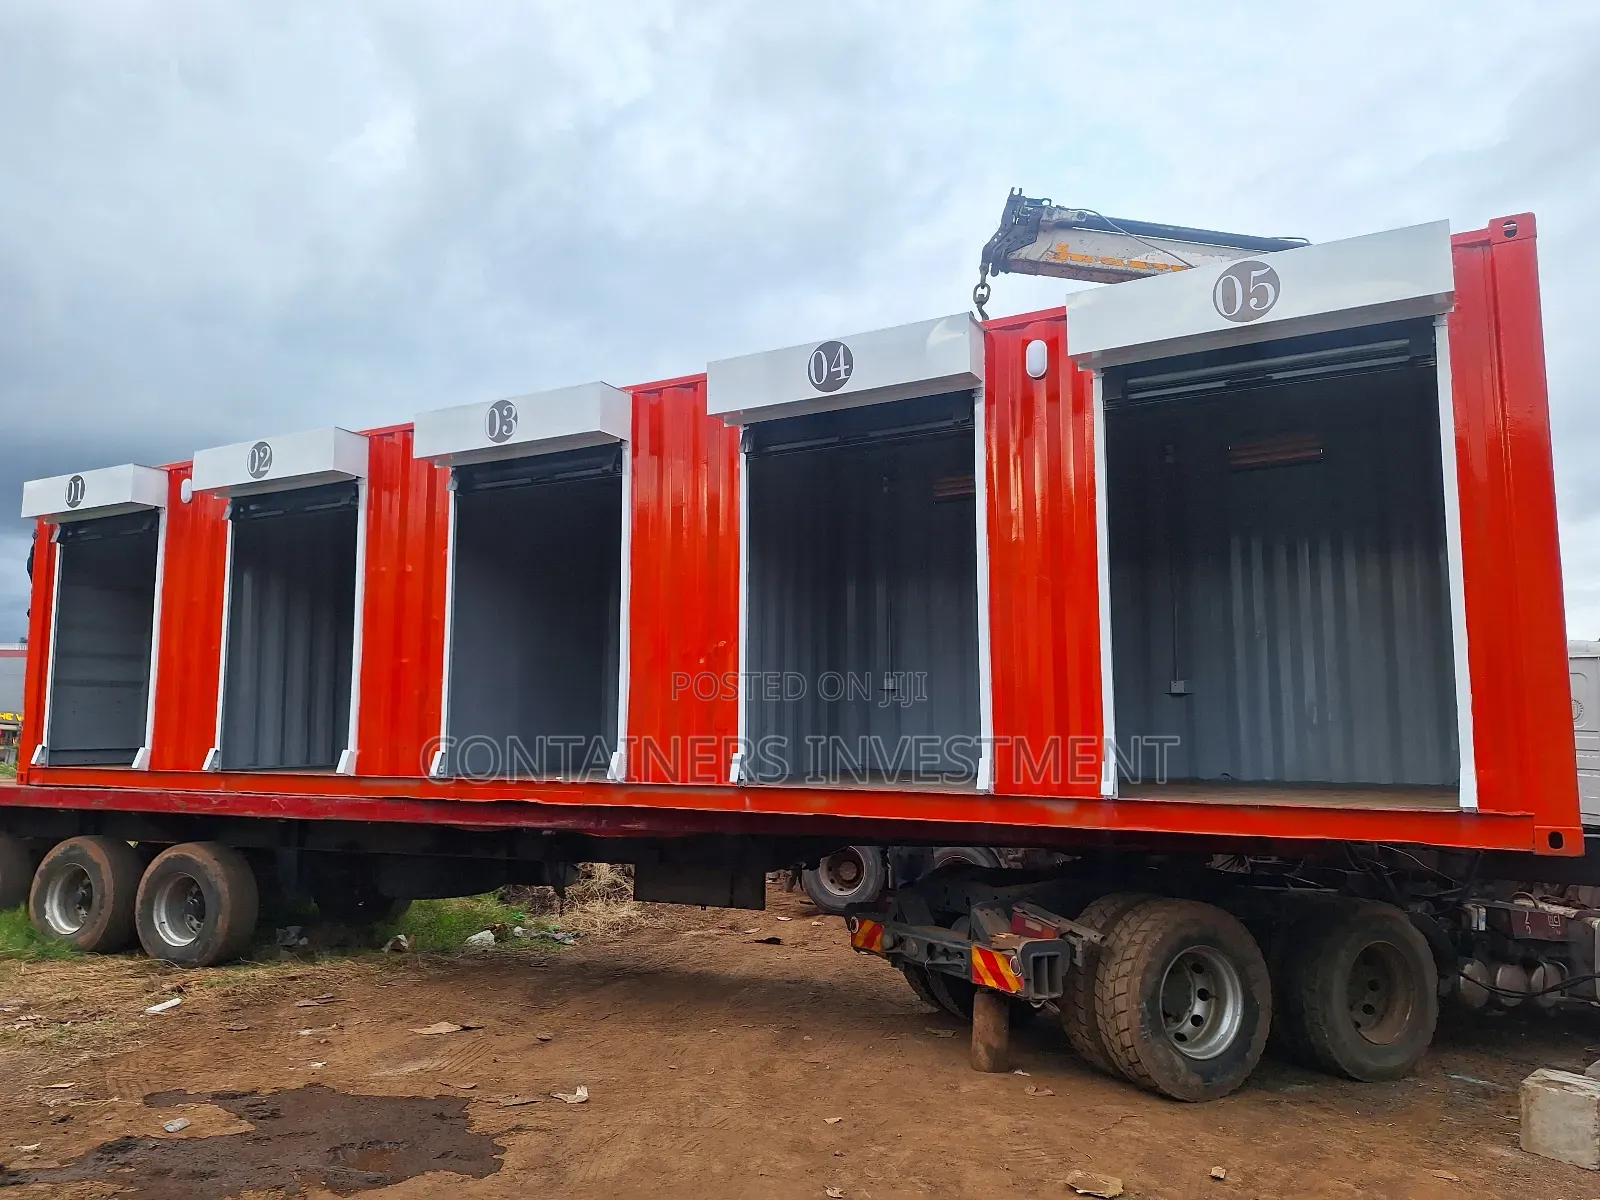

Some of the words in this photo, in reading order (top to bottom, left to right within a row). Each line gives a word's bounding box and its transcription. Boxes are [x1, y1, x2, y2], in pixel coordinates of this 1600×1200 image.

[1215, 266, 1275, 317] 05
[810, 344, 850, 385] 04
[485, 404, 517, 438] 03
[248, 445, 271, 474] 02
[66, 479, 83, 504] 01
